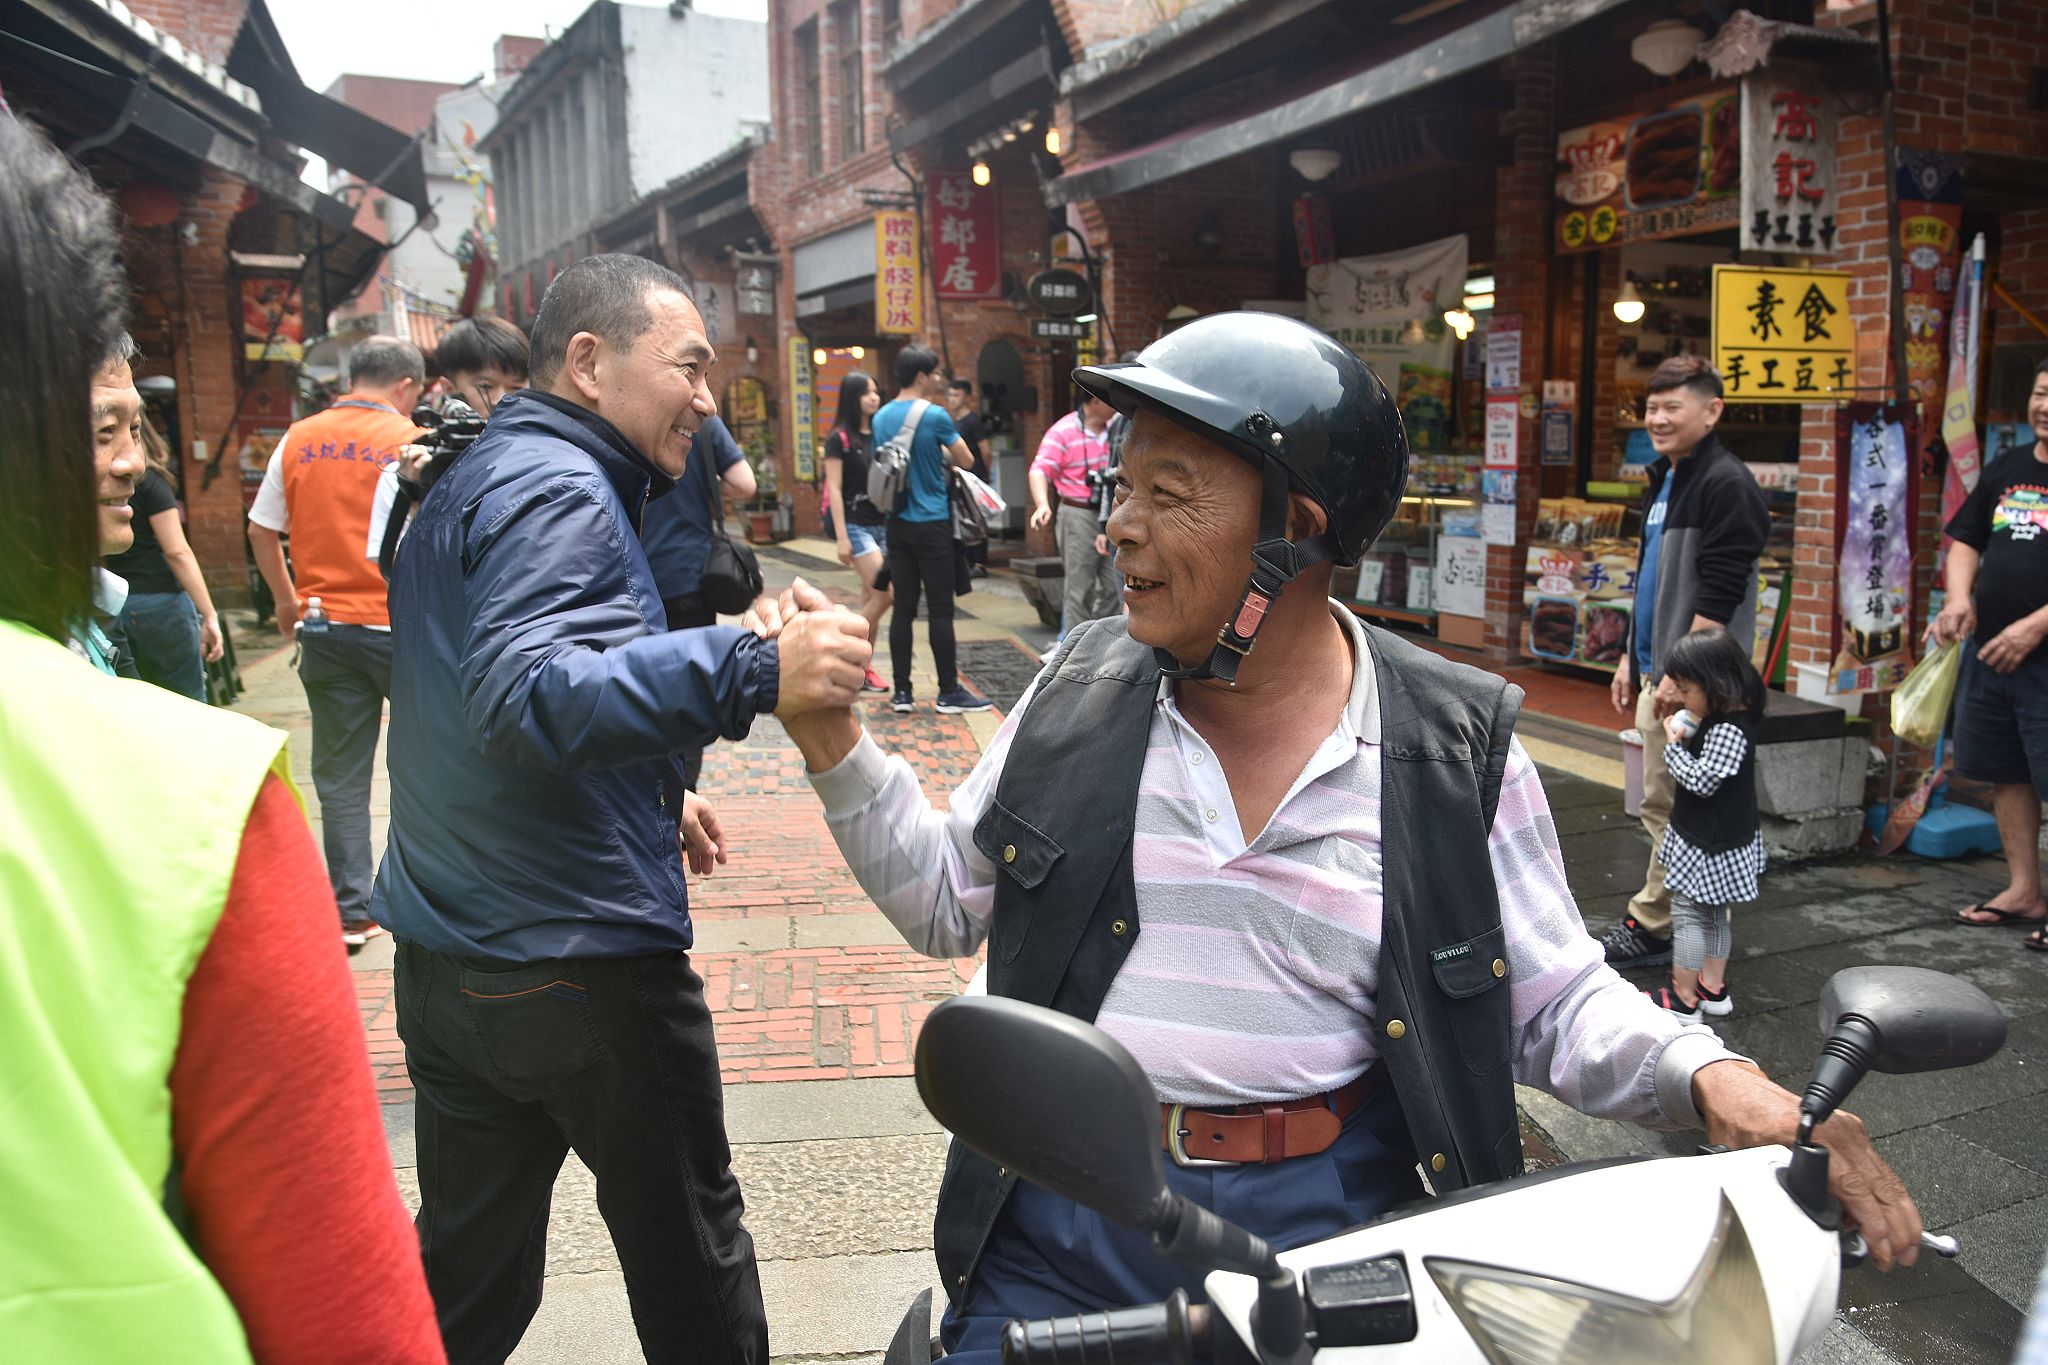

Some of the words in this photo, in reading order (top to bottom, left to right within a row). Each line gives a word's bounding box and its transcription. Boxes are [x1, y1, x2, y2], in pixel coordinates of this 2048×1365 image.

[1771, 91, 1825, 202] 高記
[1751, 209, 1836, 251] 手工豆干
[1747, 280, 1837, 342] 素食
[1723, 354, 1852, 392] 手工豆干
